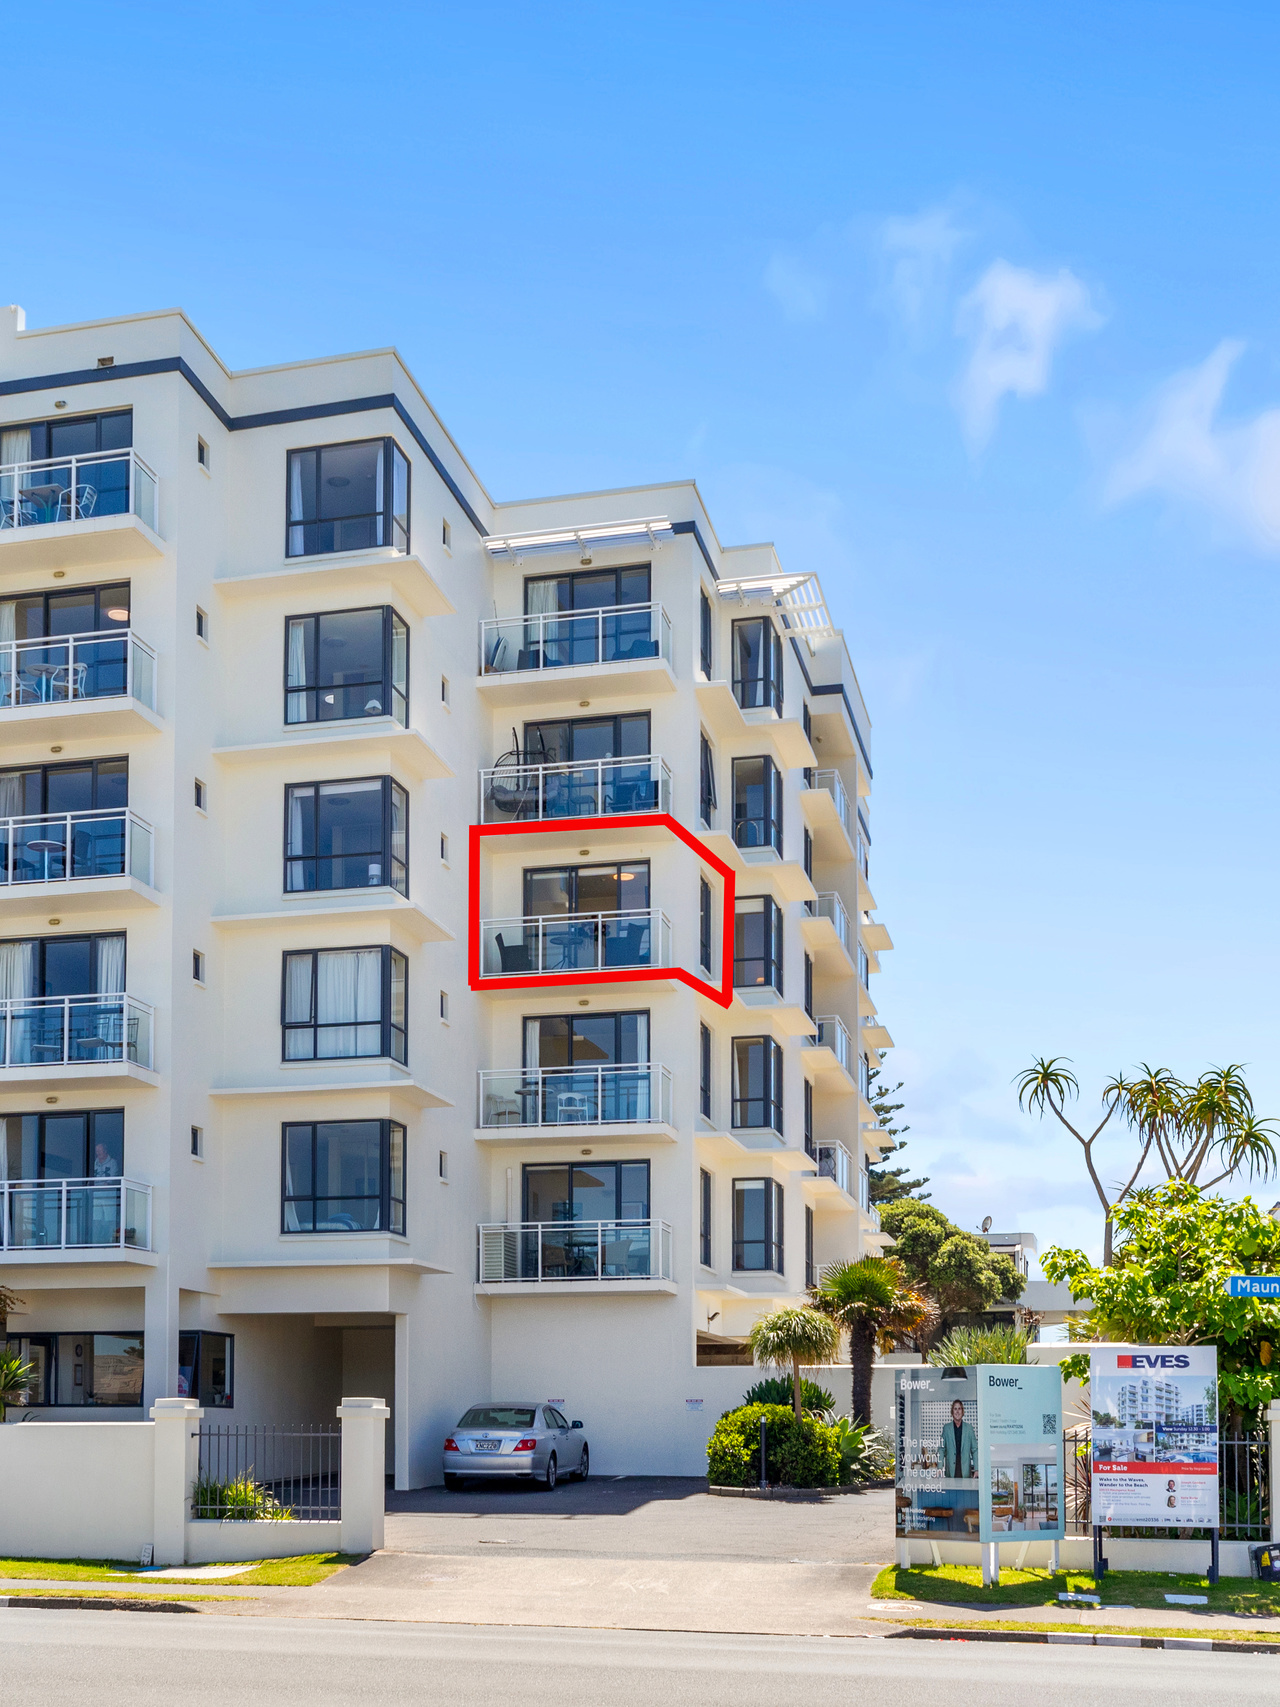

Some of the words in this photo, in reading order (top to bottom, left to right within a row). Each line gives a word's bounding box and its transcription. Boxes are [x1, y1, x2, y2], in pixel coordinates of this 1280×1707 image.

[1237, 1279, 1280, 1293] Maun
[1131, 1354, 1190, 1369] EVES
[901, 1436, 918, 1448] The
[919, 1436, 945, 1448] result
[901, 1453, 917, 1464] you
[901, 1465, 918, 1477] The
[919, 1466, 946, 1480] agent
[901, 1483, 917, 1494] you
